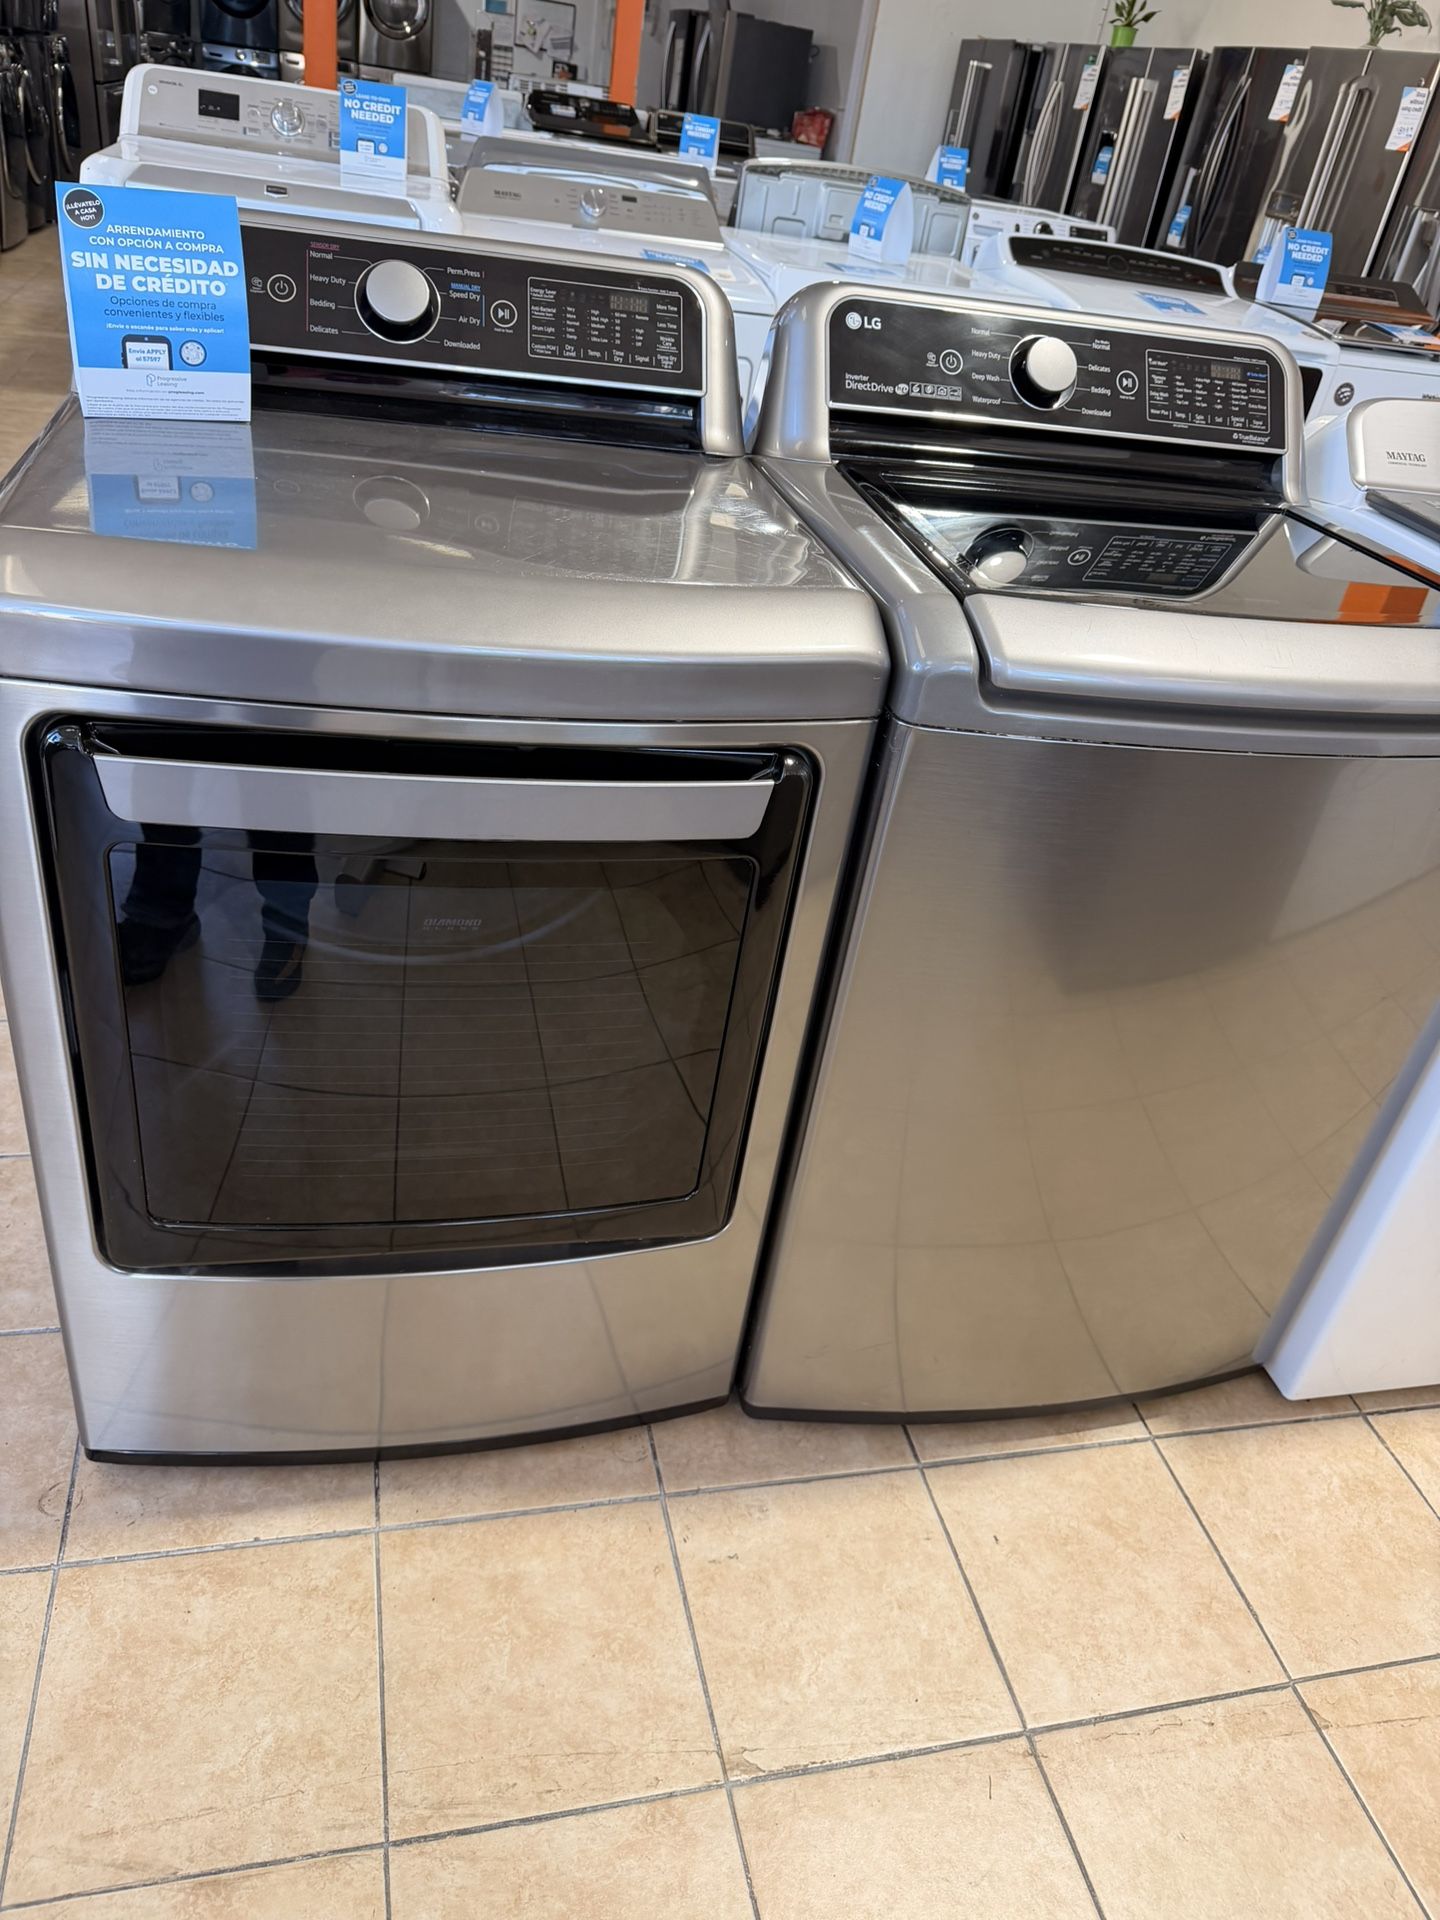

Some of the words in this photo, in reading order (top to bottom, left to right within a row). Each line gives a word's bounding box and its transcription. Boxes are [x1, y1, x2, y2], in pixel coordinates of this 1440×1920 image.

[344, 98, 361, 109] NO
[363, 101, 402, 115] CREDIT
[351, 109, 394, 124] NEEDED
[106, 224, 205, 240] ARRENDAMIENTO
[89, 235, 115, 246] CON
[117, 237, 162, 250] OPCIÓN
[165, 241, 173, 250] A
[175, 242, 224, 254] COMPRA
[1287, 242, 1300, 251] NO
[1301, 243, 1329, 256] CREDIT
[309, 251, 333, 260] Normal
[1291, 250, 1324, 263] NEEDED
[71, 251, 109, 269] SIN
[114, 254, 239, 277] NECESIDAD
[96, 273, 127, 291] DE
[131, 272, 227, 297] CRÉDITO
[309, 273, 329, 284] Heavy
[330, 275, 346, 286] Duty
[449, 289, 468, 299] Speed
[469, 291, 480, 301] Dry
[110, 295, 160, 308] Opciones
[162, 298, 175, 308] de
[178, 300, 217, 311] compra
[309, 298, 336, 310] Bedding
[104, 307, 173, 320] convenientes
[175, 311, 182, 321] y
[183, 310, 225, 322] flexibles
[469, 316, 480, 326] Dry
[864, 316, 882, 330] LG
[203, 327, 225, 335] aplicar!
[309, 325, 339, 335] Delicates
[971, 327, 991, 336] Normal
[444, 339, 481, 350] Downloaded
[1092, 342, 1111, 351] Normal
[146, 348, 167, 356] APPLY
[971, 349, 989, 359] Heavy
[989, 351, 1001, 360] Duty
[613, 355, 623, 363] Dry
[1088, 363, 1111, 373] Delicates
[157, 376, 188, 384] Progressive
[845, 372, 870, 382] Inverter
[971, 372, 986, 382] Deep
[986, 374, 1000, 382] Wash
[845, 379, 894, 393] DirectDrive
[1090, 386, 1111, 397] Bedding
[972, 395, 1001, 405] Waterproof
[1081, 407, 1112, 417] Downloaded
[1386, 451, 1426, 462] MAYTAG
[423, 918, 482, 927] DIAMOND
